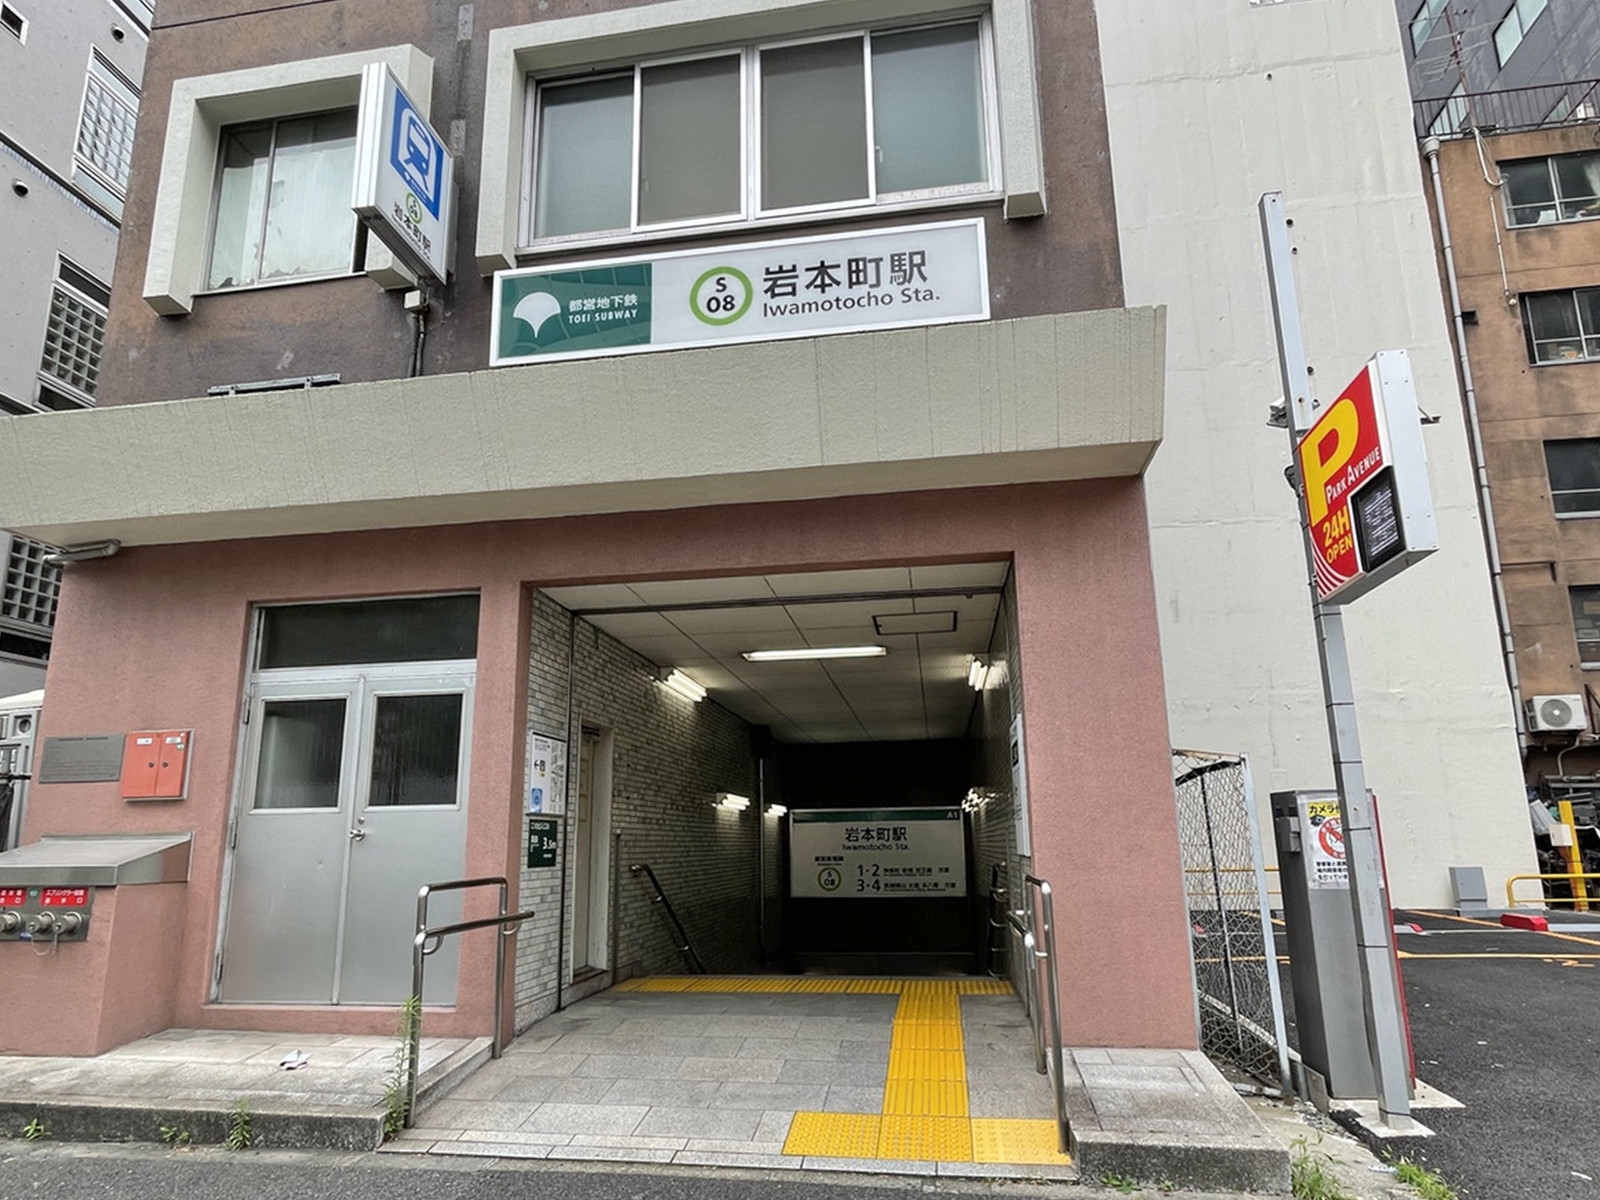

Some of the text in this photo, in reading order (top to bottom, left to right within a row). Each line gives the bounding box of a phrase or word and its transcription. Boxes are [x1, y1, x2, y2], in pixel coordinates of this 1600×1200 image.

[715, 276, 728, 293] S
[763, 250, 928, 299] 岩本町駅
[568, 293, 638, 312] 都営地下鉄
[706, 294, 736, 313] 08
[763, 287, 940, 317] Iwamotocho Sta.
[568, 309, 638, 324] TOEI SUBWAY
[1301, 398, 1358, 528] P
[1323, 505, 1350, 548] 24H
[1326, 533, 1353, 564] OPEN
[845, 827, 907, 842] 岩本町駅
